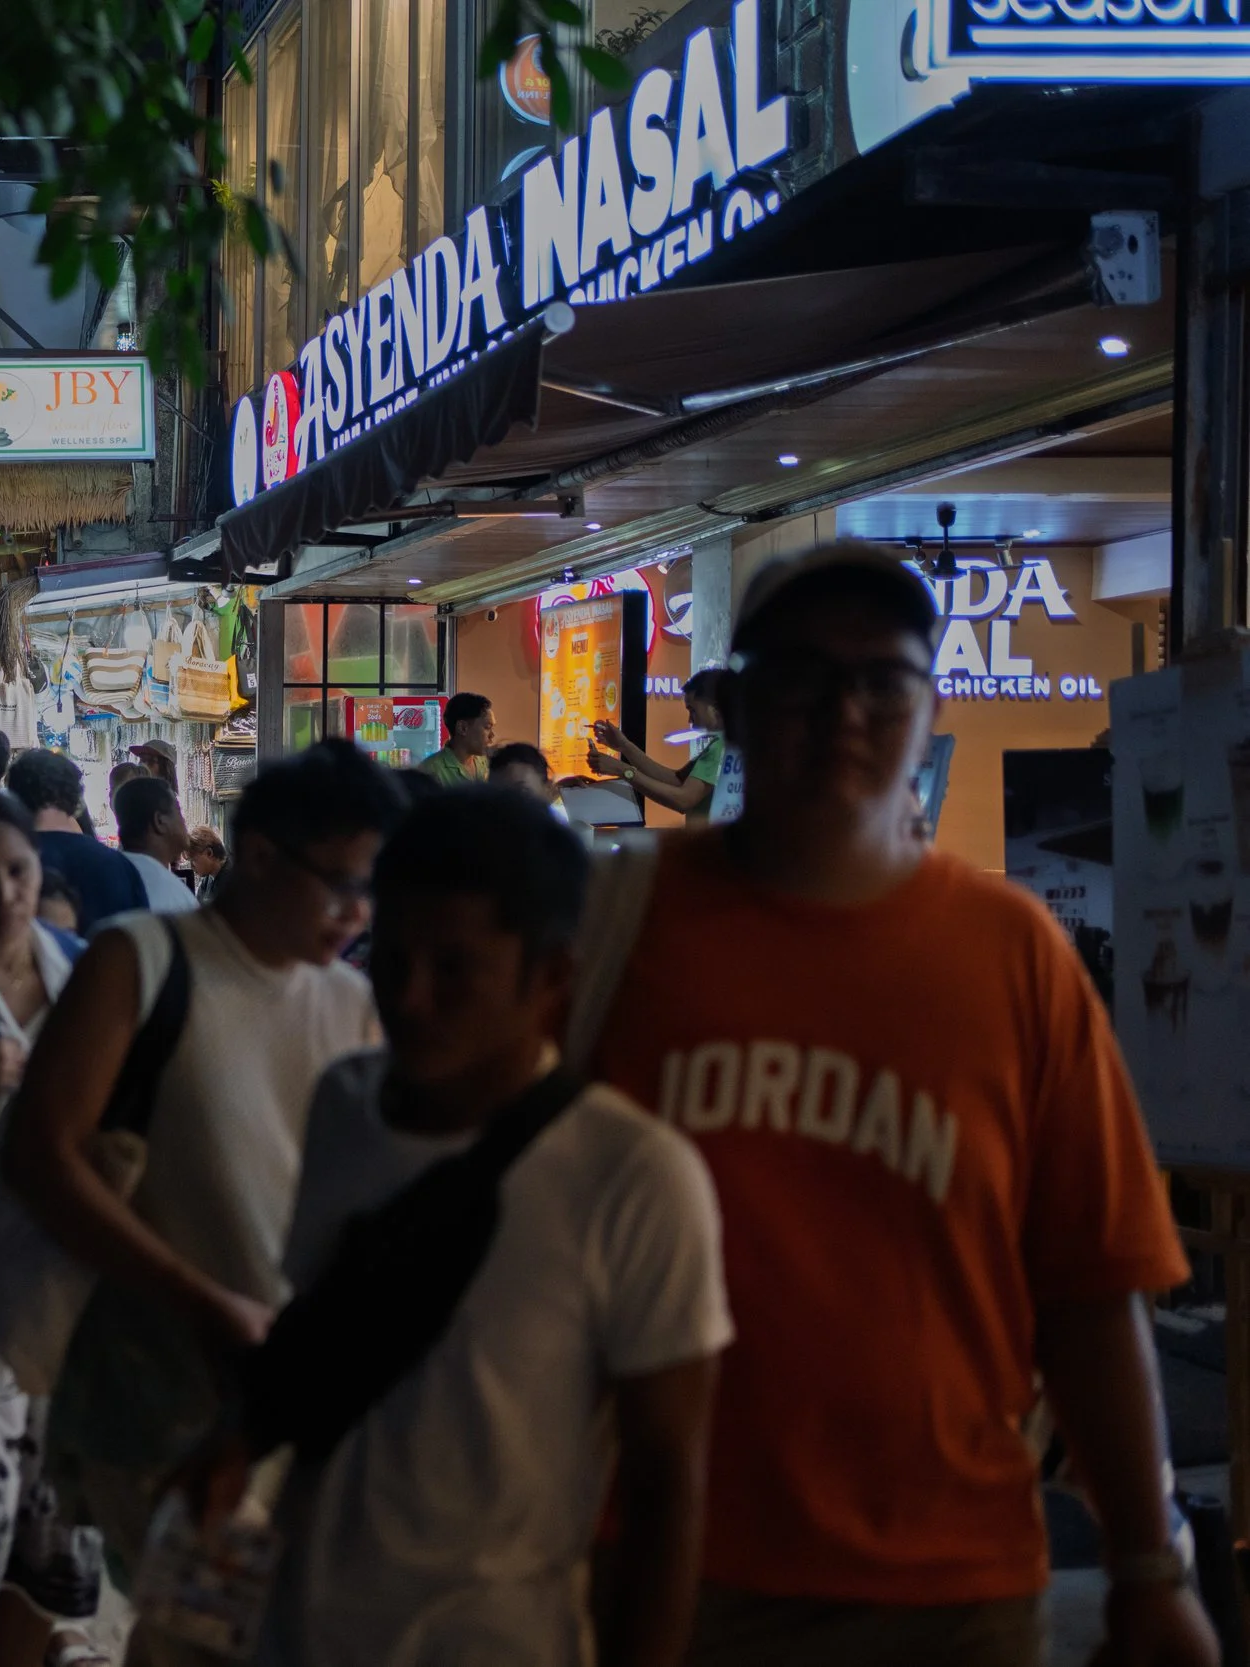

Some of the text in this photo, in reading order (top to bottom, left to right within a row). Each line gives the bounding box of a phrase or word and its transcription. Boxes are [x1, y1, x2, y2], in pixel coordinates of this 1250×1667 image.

[293, 204, 507, 474] ASYENDA
[45, 370, 135, 412] JBY
[51, 435, 128, 445] WELLNESS SPA
[572, 640, 588, 654] MENU
[185, 655, 221, 671] Boracay
[645, 676, 685, 694] UNL
[937, 677, 1103, 697] CHICKEN OIL
[659, 1040, 960, 1204] JORDAN
